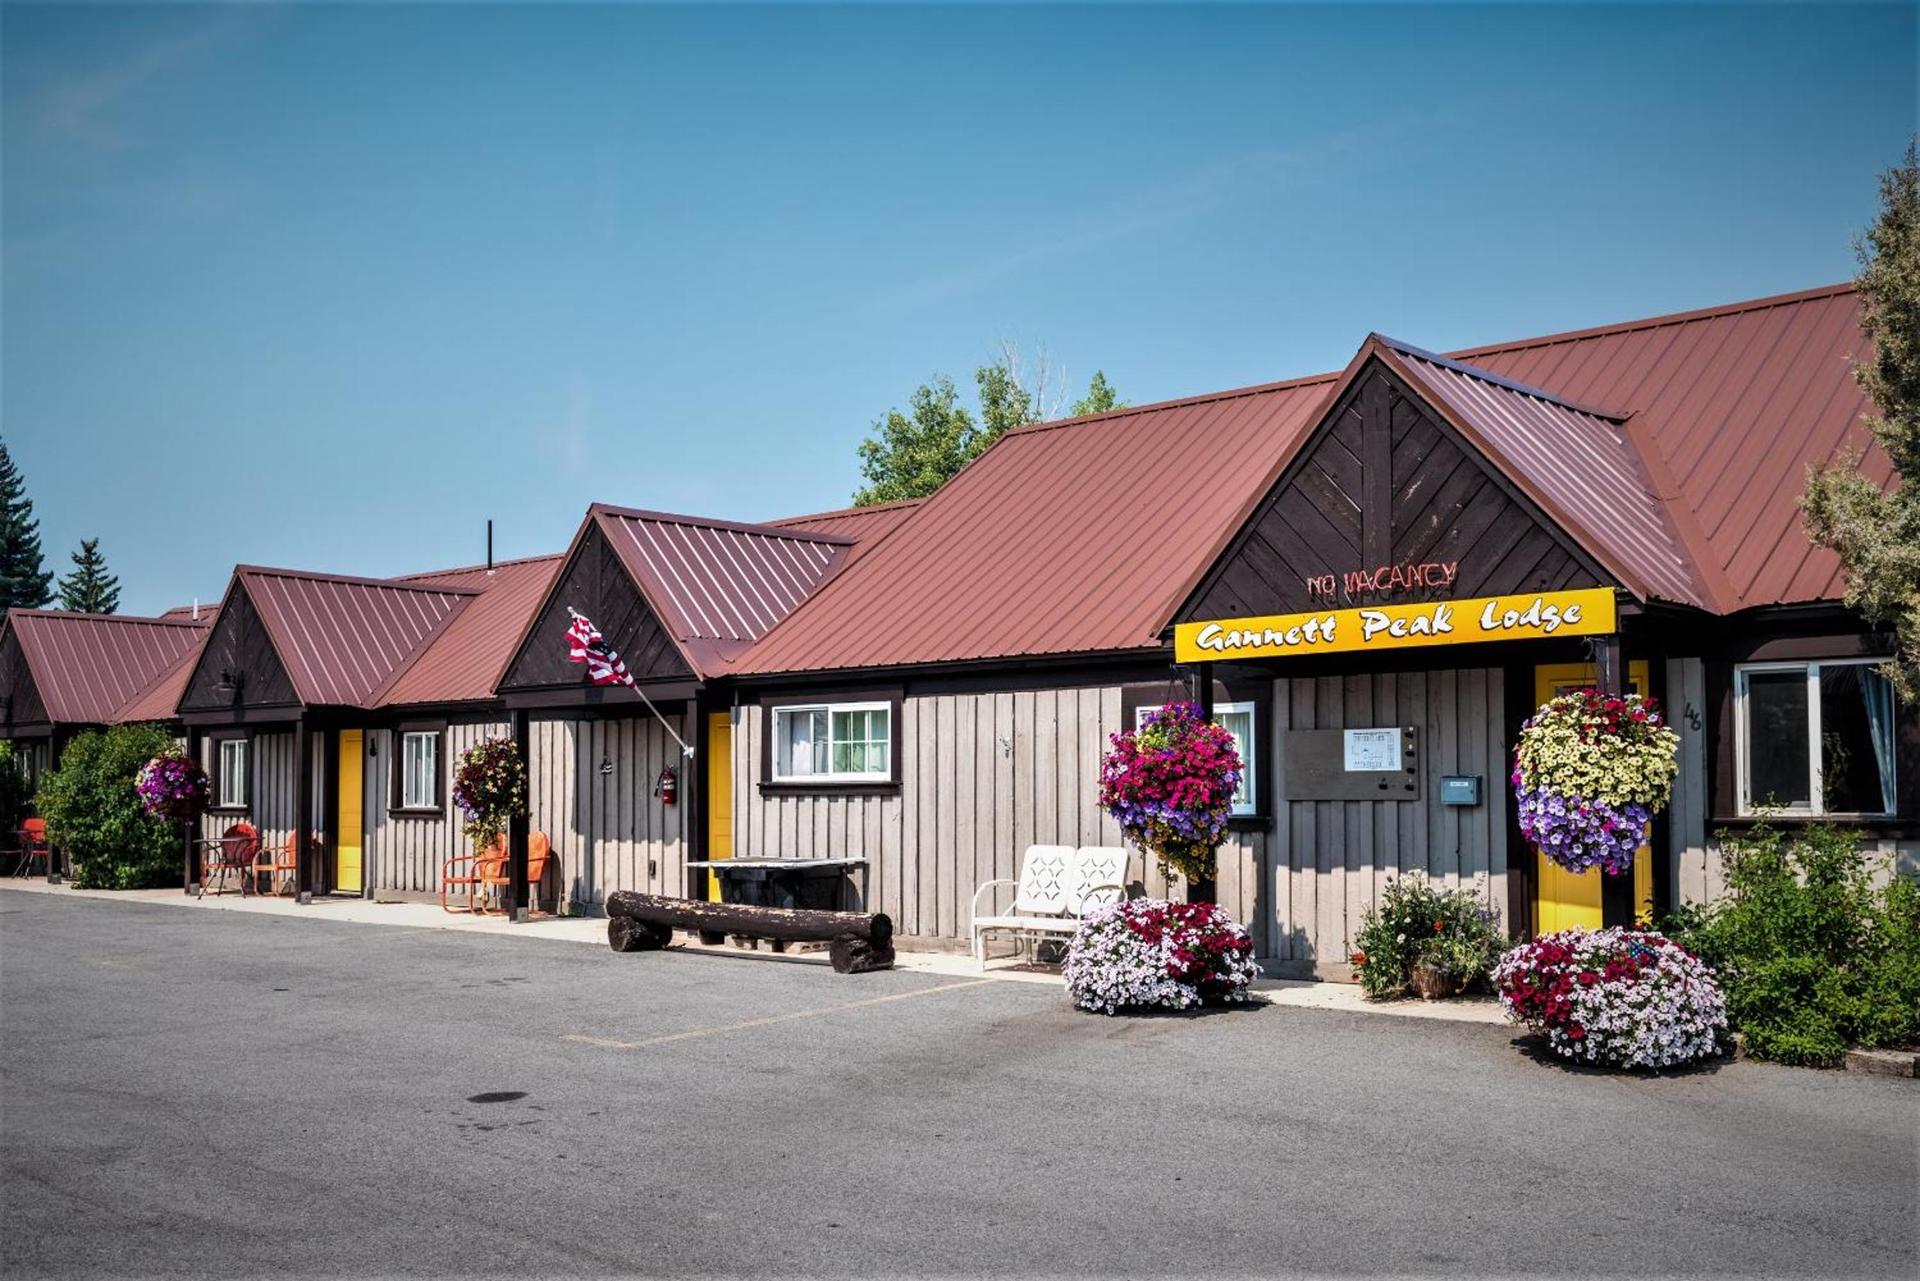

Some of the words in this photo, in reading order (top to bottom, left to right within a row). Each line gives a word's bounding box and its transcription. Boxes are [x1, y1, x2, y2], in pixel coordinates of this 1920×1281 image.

[1307, 574, 1336, 594] NO
[1343, 561, 1458, 594] VACANCY
[1195, 615, 1337, 652] Gannett
[1360, 603, 1454, 642] Peak
[1480, 597, 1583, 634] Lodge
[1683, 702, 1702, 731] 46
